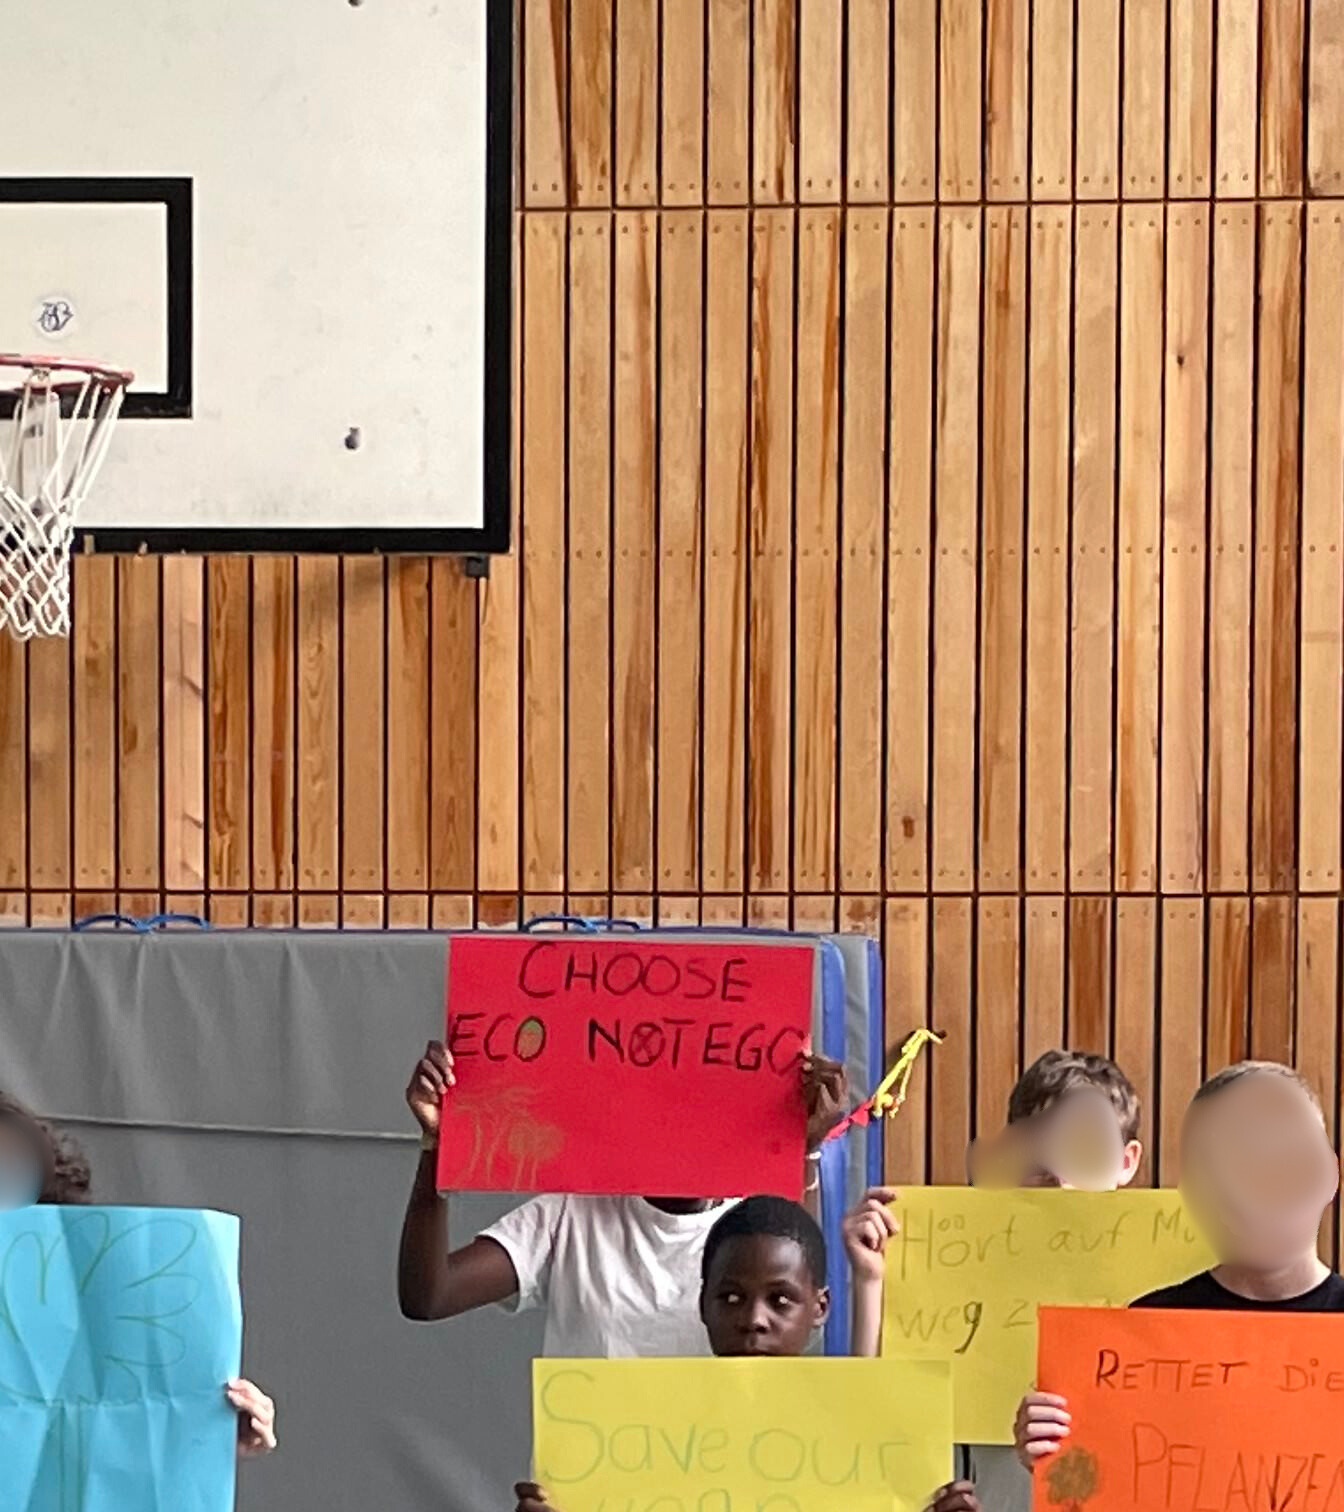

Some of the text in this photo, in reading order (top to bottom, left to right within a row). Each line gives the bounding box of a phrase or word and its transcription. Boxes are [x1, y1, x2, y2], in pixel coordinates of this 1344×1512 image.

[518, 940, 753, 1002] CHOOSE
[448, 1011, 547, 1063] ECO
[588, 1017, 696, 1070] NOT
[899, 1207, 1023, 1281] Hört
[1095, 1348, 1250, 1392] RETTET
[540, 1369, 731, 1485] Save
